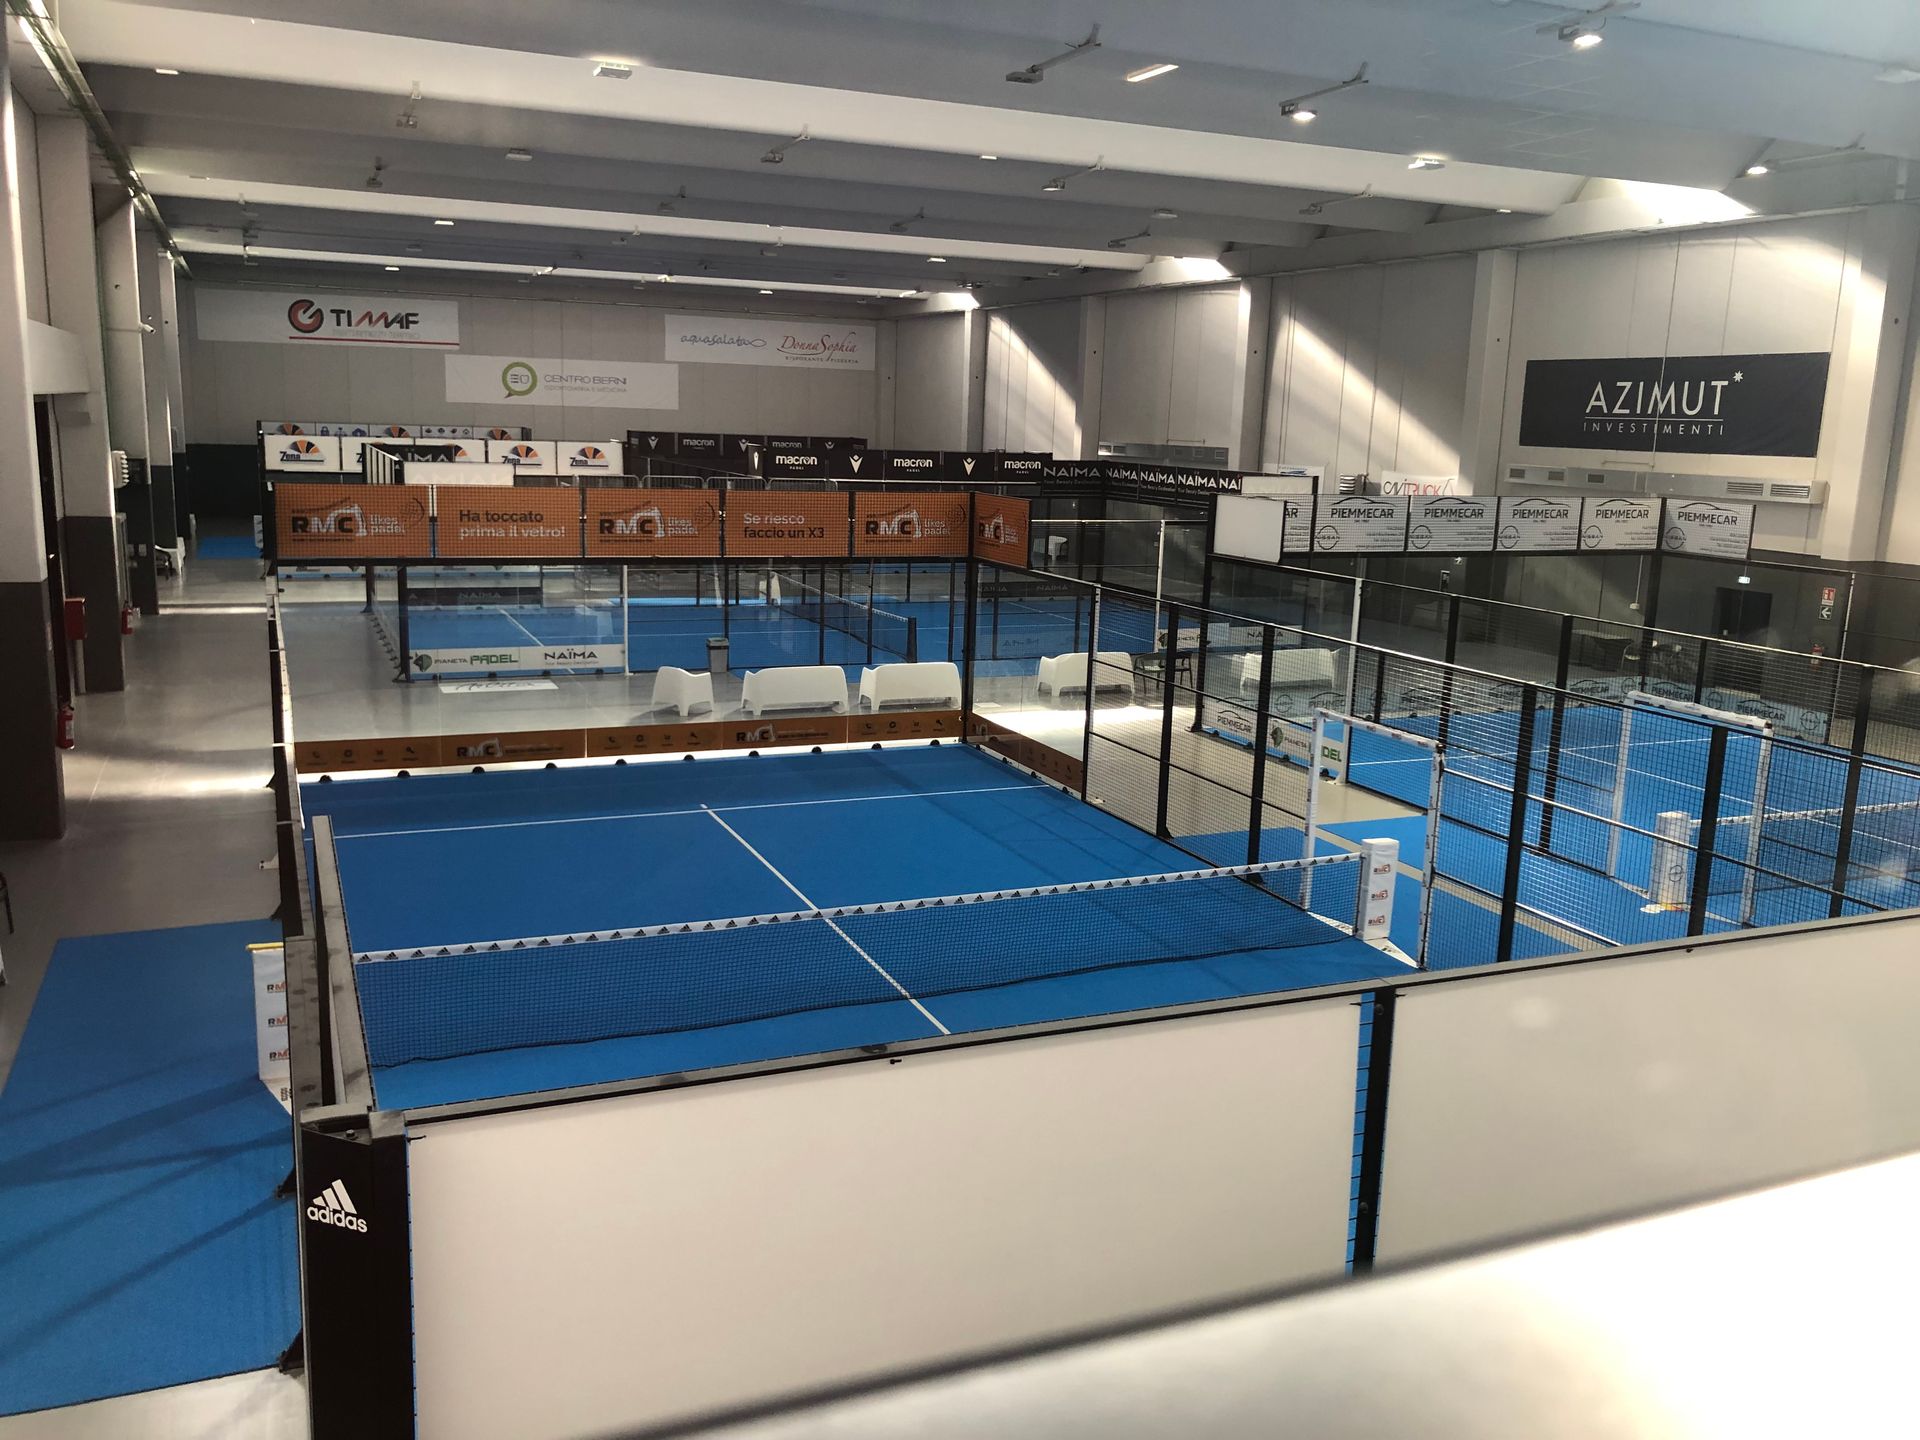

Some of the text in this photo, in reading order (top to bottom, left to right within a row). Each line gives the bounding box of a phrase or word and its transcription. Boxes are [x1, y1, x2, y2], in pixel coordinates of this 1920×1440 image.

[780, 331, 857, 357] Donna Sophia
[544, 374, 627, 385] CENTRO BERNI
[1585, 381, 1729, 416] AZIMUT
[1583, 421, 1724, 436] INVESTIMENTI
[683, 439, 715, 447] macron
[772, 441, 803, 449] macron
[775, 455, 818, 465] macron
[893, 458, 933, 468] macron
[1004, 460, 1041, 470] macron
[1178, 471, 1217, 489] NAÏMA
[460, 510, 544, 523] Ha toccato
[743, 512, 805, 524] Se riesco
[1330, 508, 1395, 519] PIEMMECAR
[1424, 508, 1484, 519] PIEMMECAR
[1512, 509, 1569, 519] PIEMMECAR
[1595, 509, 1650, 519] PIEMMECAR
[1678, 511, 1738, 526] PIEMMECAR
[460, 525, 566, 540] prima il vetro!
[744, 527, 825, 538] faccio un X3
[544, 648, 598, 660] NAÏMA
[469, 654, 519, 666] PADEL
[1735, 704, 1786, 721] PIEMMECAR
[267, 982, 287, 992] RM
[268, 1016, 288, 1026] RM
[269, 1049, 289, 1059] RM
[307, 1205, 368, 1233] adidas
